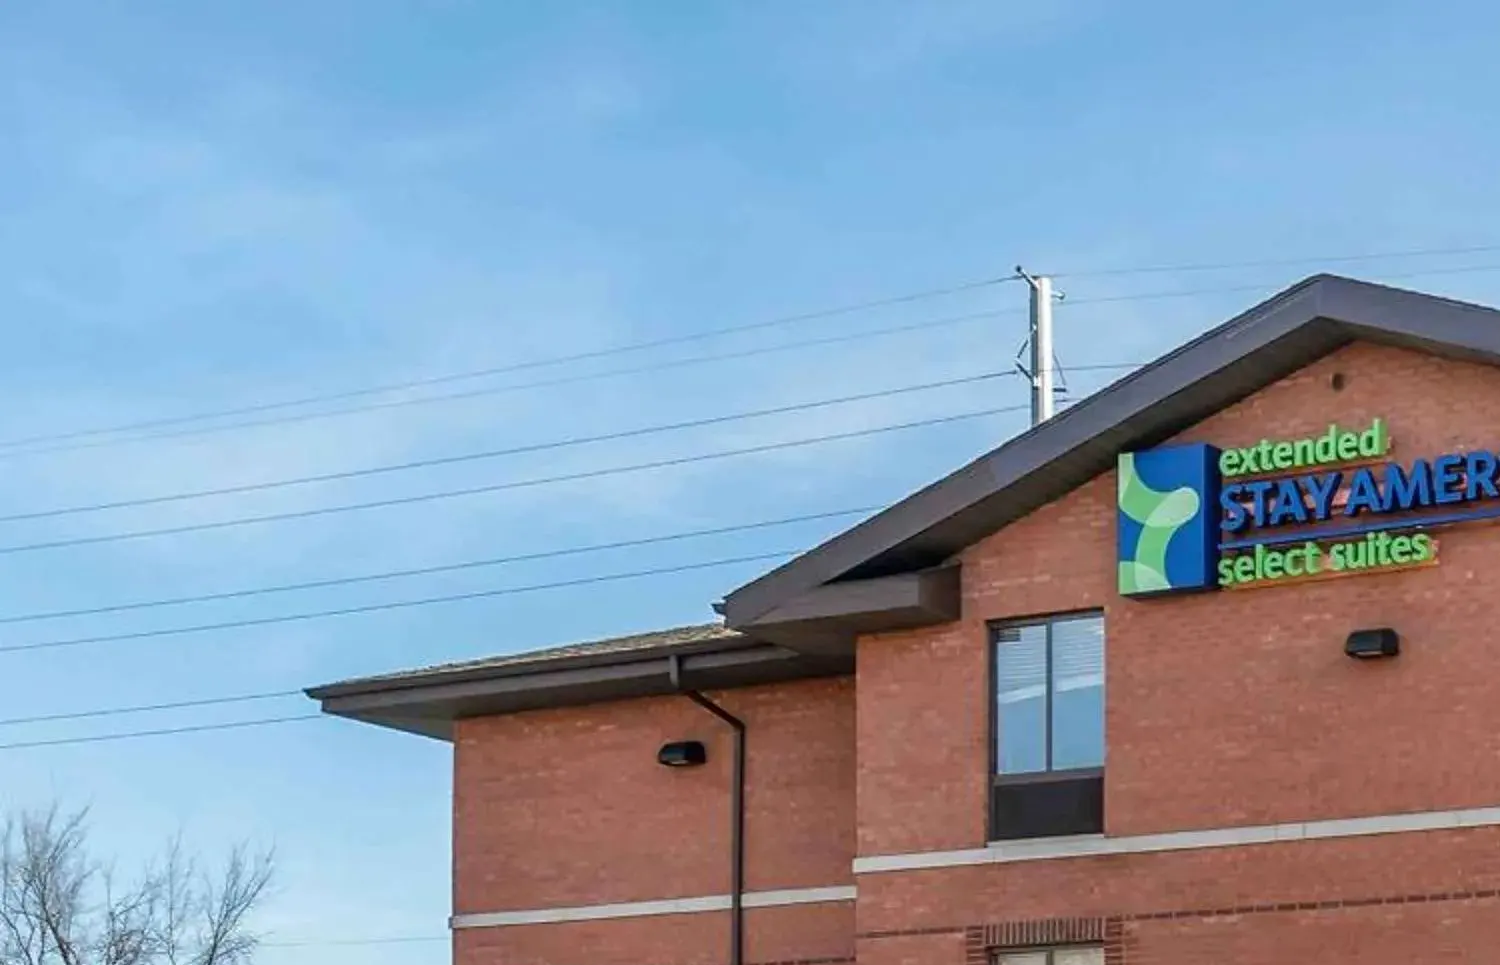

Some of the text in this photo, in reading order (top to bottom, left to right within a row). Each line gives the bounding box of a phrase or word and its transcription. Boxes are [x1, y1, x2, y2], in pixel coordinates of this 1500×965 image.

[1218, 419, 1383, 476] extended
[1218, 531, 1431, 587] select suites
